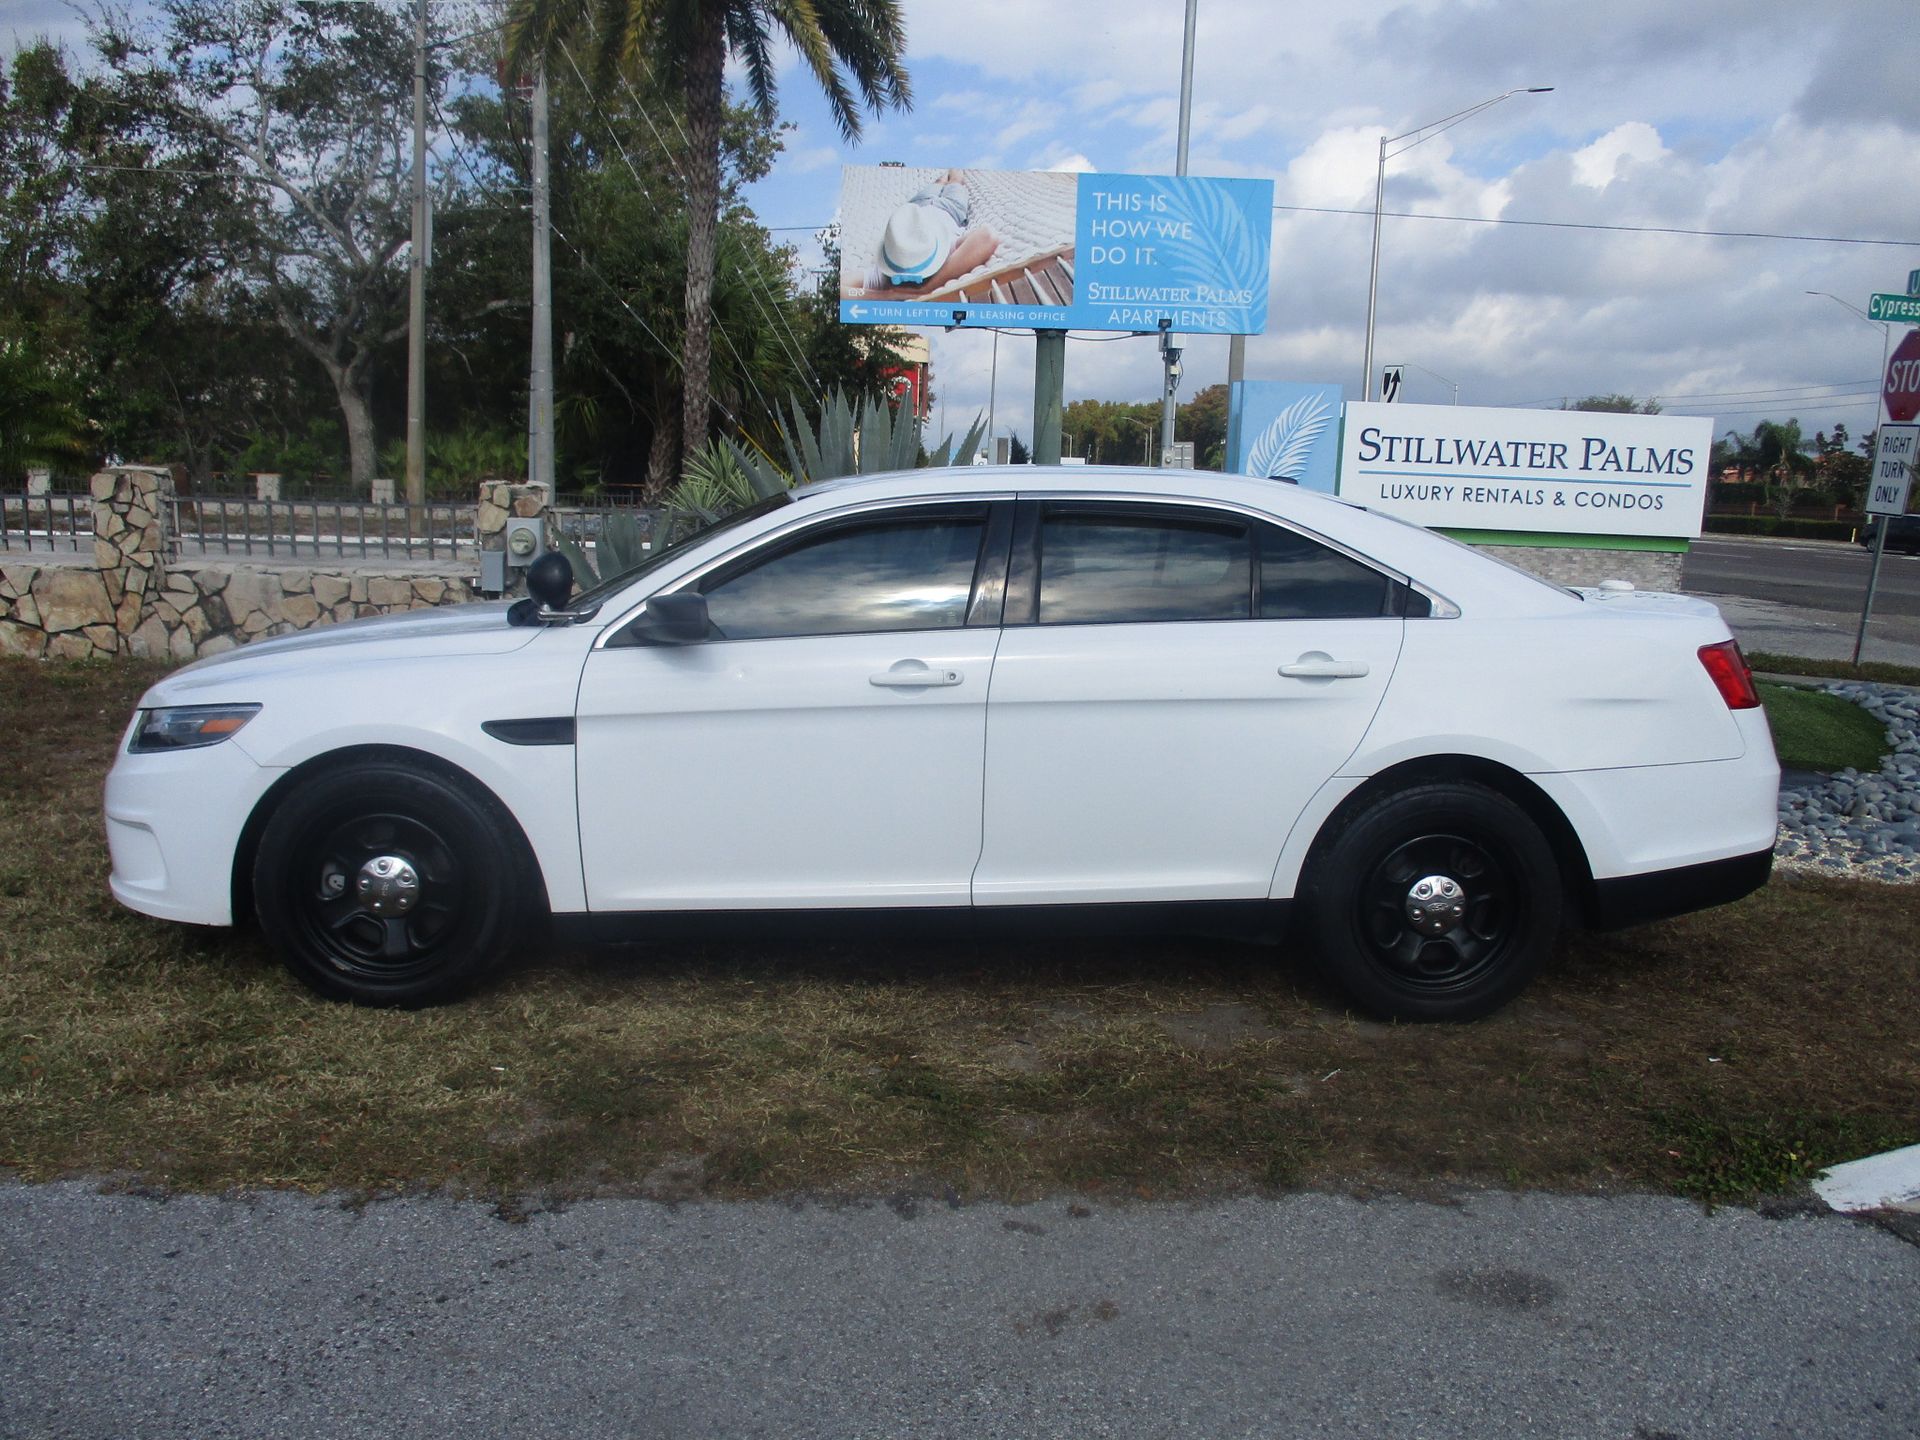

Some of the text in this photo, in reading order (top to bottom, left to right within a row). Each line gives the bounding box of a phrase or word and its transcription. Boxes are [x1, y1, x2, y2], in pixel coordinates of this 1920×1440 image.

[1092, 192, 1168, 213] THIS IS
[1091, 219, 1193, 240] HOW WE
[1090, 246, 1158, 266] DO IT.
[1088, 281, 1253, 304] STILLWATER PALMS
[872, 307, 902, 317] TURN
[906, 308, 929, 318] LEFT
[933, 309, 948, 318] TO
[980, 310, 1025, 321] LEASING
[1028, 311, 1066, 321] OFFICE
[1870, 295, 1920, 319] Cypress
[1108, 308, 1226, 327] APARTMENTS
[1358, 427, 1694, 475] STILLWATER PALMS
[1882, 436, 1912, 454] RIGHT
[1880, 461, 1905, 479] TURN
[1380, 483, 1664, 511] LUXURY RENTALS & CONDOS
[1875, 485, 1900, 503] ONLY
